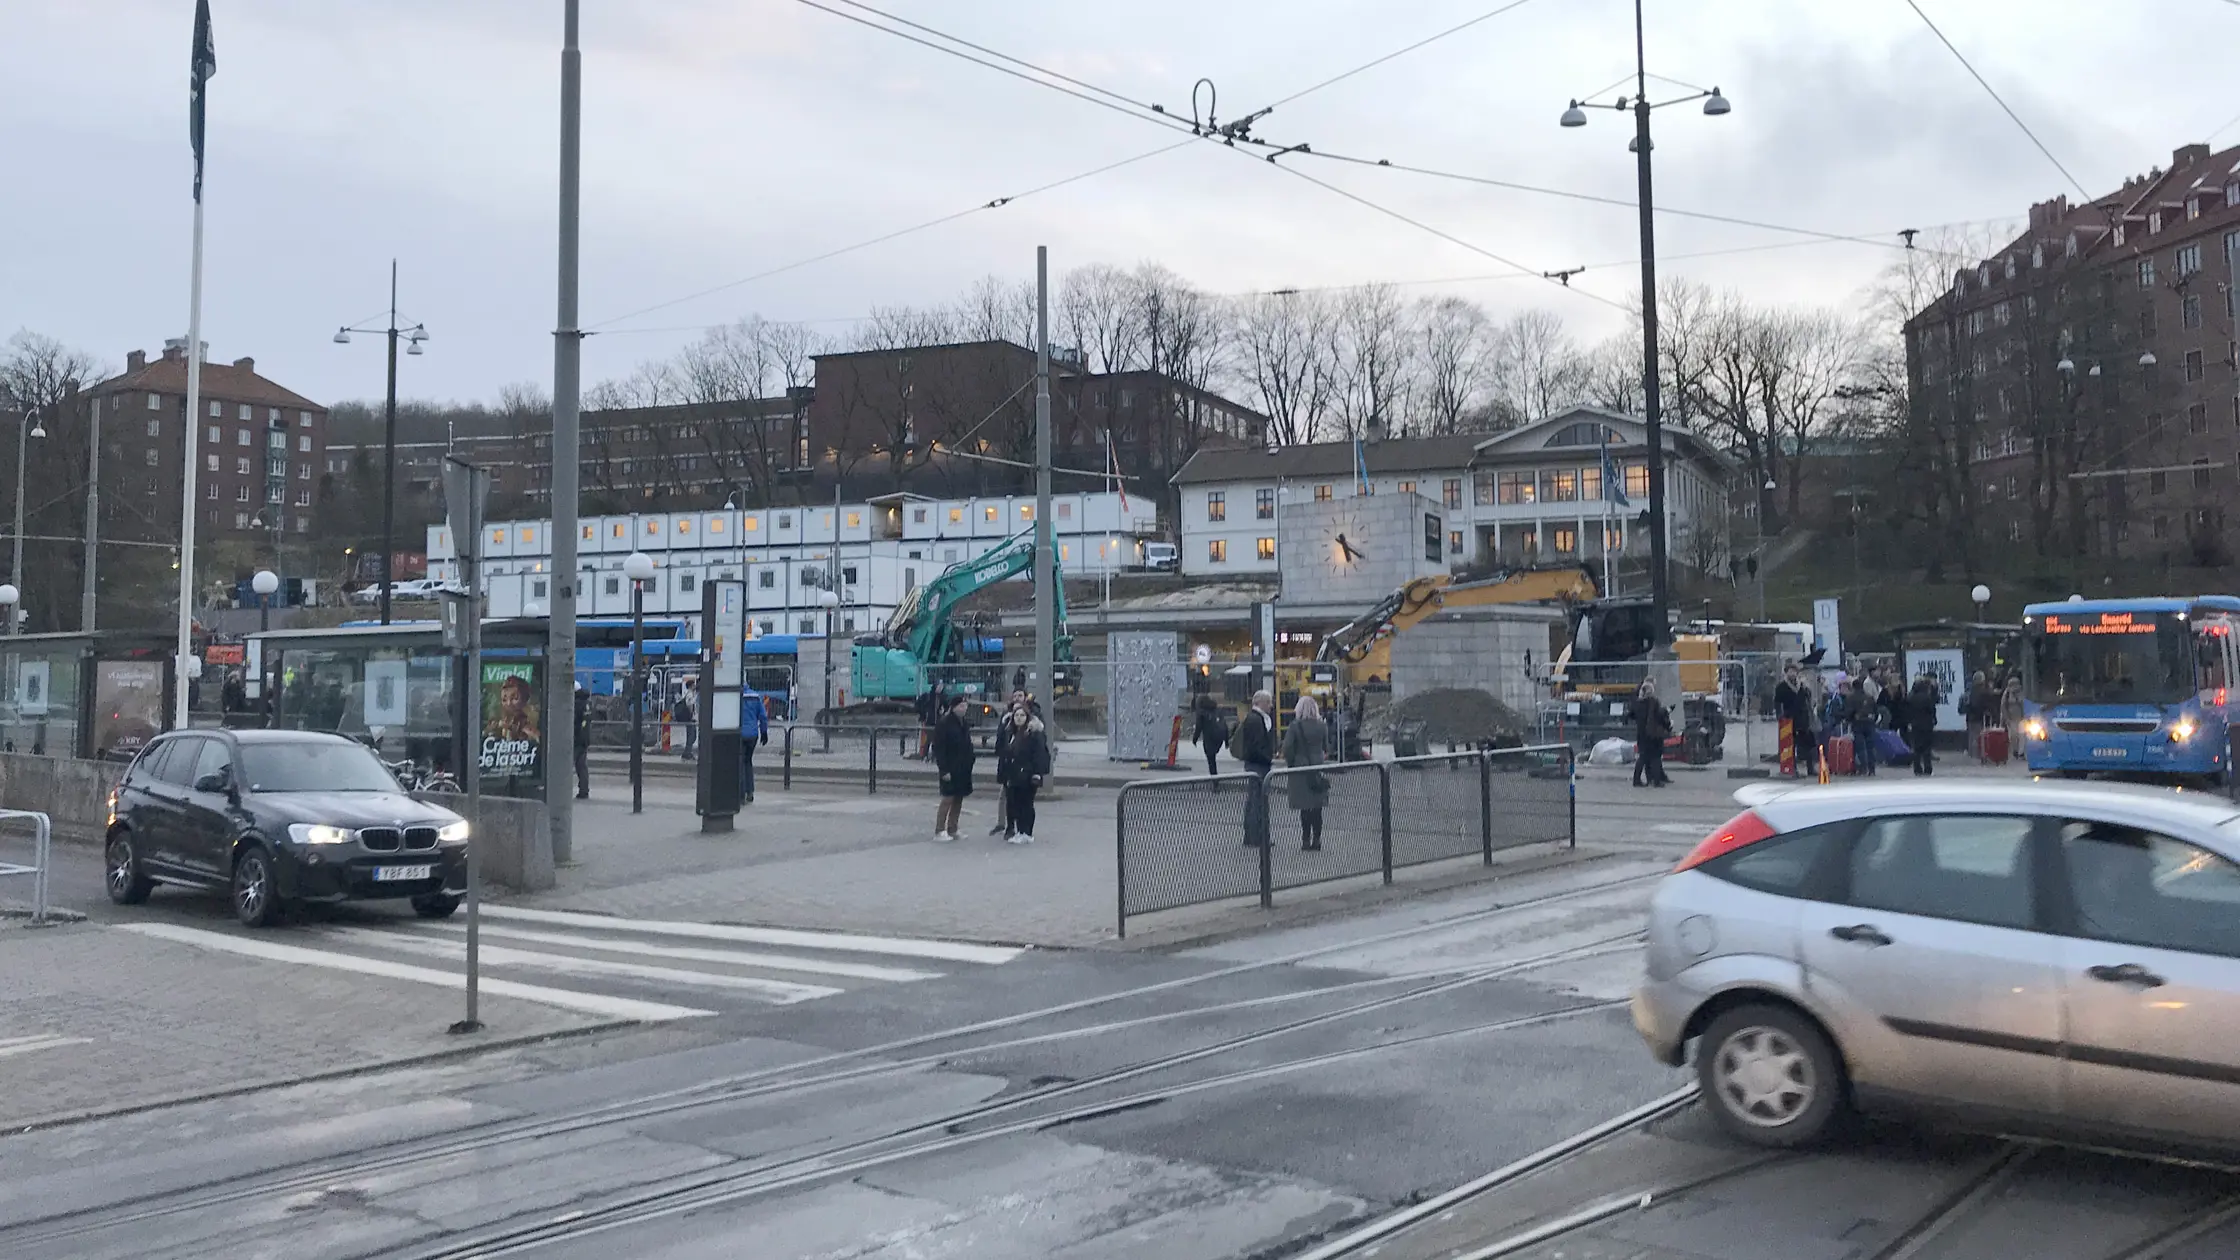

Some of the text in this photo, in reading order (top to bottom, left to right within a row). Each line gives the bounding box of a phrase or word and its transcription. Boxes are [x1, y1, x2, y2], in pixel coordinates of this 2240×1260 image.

[974, 561, 1009, 584] KOBELCO
[1821, 603, 1831, 620] D
[483, 736, 529, 753] Crème
[496, 749, 509, 767] la
